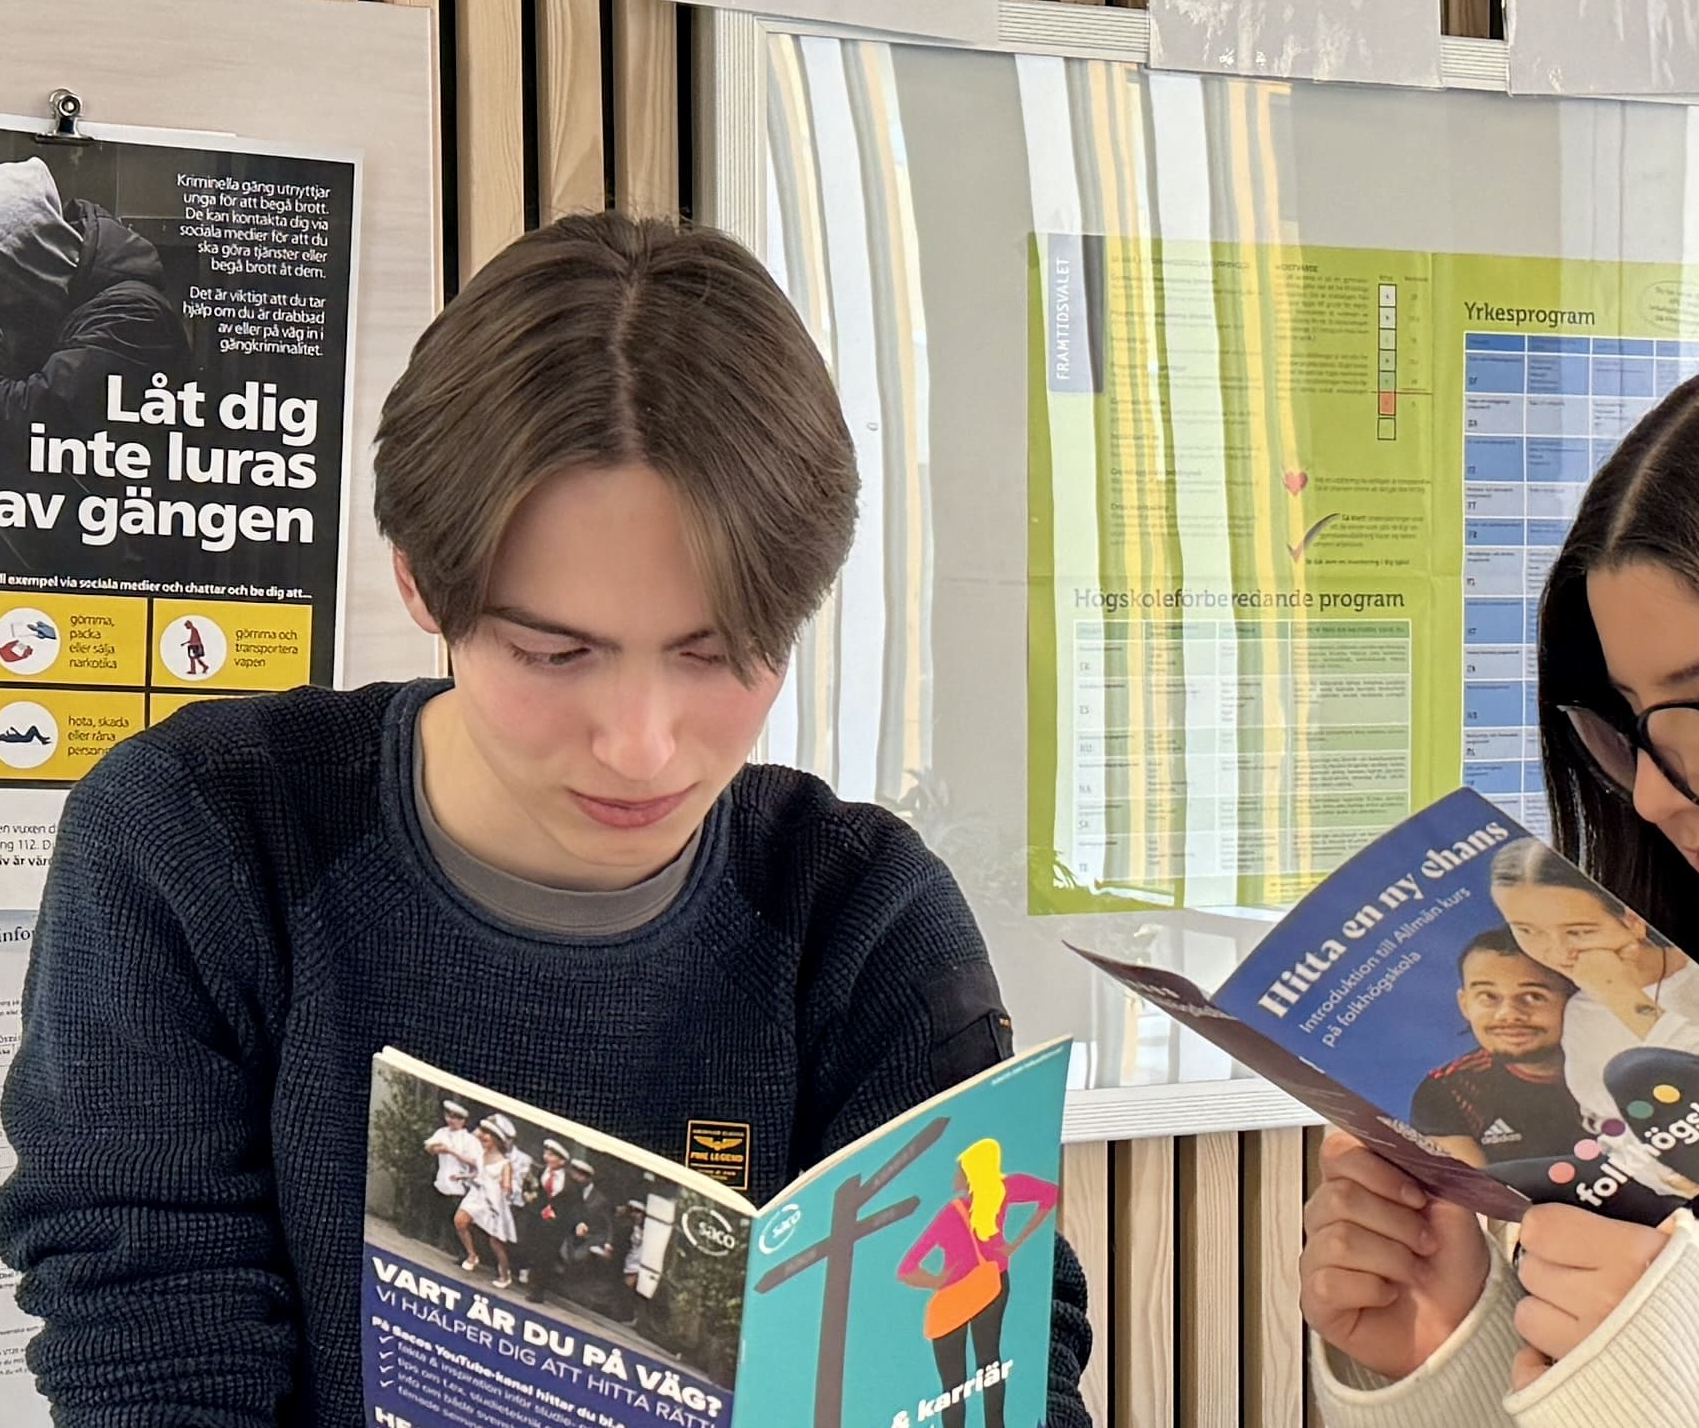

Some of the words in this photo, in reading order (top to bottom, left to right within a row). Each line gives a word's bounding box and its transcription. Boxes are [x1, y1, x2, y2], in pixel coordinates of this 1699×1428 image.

[177, 173, 240, 191] Kriminella
[241, 180, 275, 197] gäng
[276, 184, 331, 201] utnyttjar
[182, 192, 217, 208] unga
[218, 192, 238, 207] för
[238, 196, 258, 209] att
[259, 195, 292, 214] begå
[294, 198, 329, 215] brott.
[184, 206, 204, 221] De
[205, 207, 230, 223] kan
[231, 209, 288, 227] kontakta
[289, 214, 310, 232] dig
[310, 216, 329, 231] via
[1057, 258, 1070, 380] FRAMTIDSVALET
[1464, 302, 1595, 328] Yrkesprogram
[108, 374, 206, 424] Låt
[218, 380, 318, 447] dig
[29, 422, 151, 479] inte
[168, 431, 317, 489] luras
[77, 486, 314, 552] gängen
[1074, 588, 1314, 612] Högskoleförberedande
[1319, 591, 1405, 613] program
[1257, 939, 1347, 1019] Hitta
[1341, 903, 1384, 939] en
[1378, 872, 1424, 910] ny
[1420, 821, 1510, 879] chans
[1299, 955, 1380, 1034] Introduktion
[1376, 938, 1397, 958] till
[1393, 899, 1443, 944] Allmän
[1438, 886, 1471, 914] kurs
[1322, 1026, 1342, 1048] på
[1340, 949, 1422, 1027] folkhögskola
[699, 1221, 735, 1249] saco
[371, 1256, 462, 1311] VART
[466, 1294, 517, 1336] ÄR
[523, 1319, 575, 1358] DU
[583, 1344, 629, 1381] PÅ
[635, 1363, 723, 1418] VÄG?
[375, 1285, 395, 1307] VI
[401, 1299, 493, 1348] HJÄLPER
[499, 1338, 537, 1367] DIG
[540, 1356, 582, 1385] ATT
[588, 1376, 651, 1412] HITTA
[918, 1359, 1014, 1422] karriär
